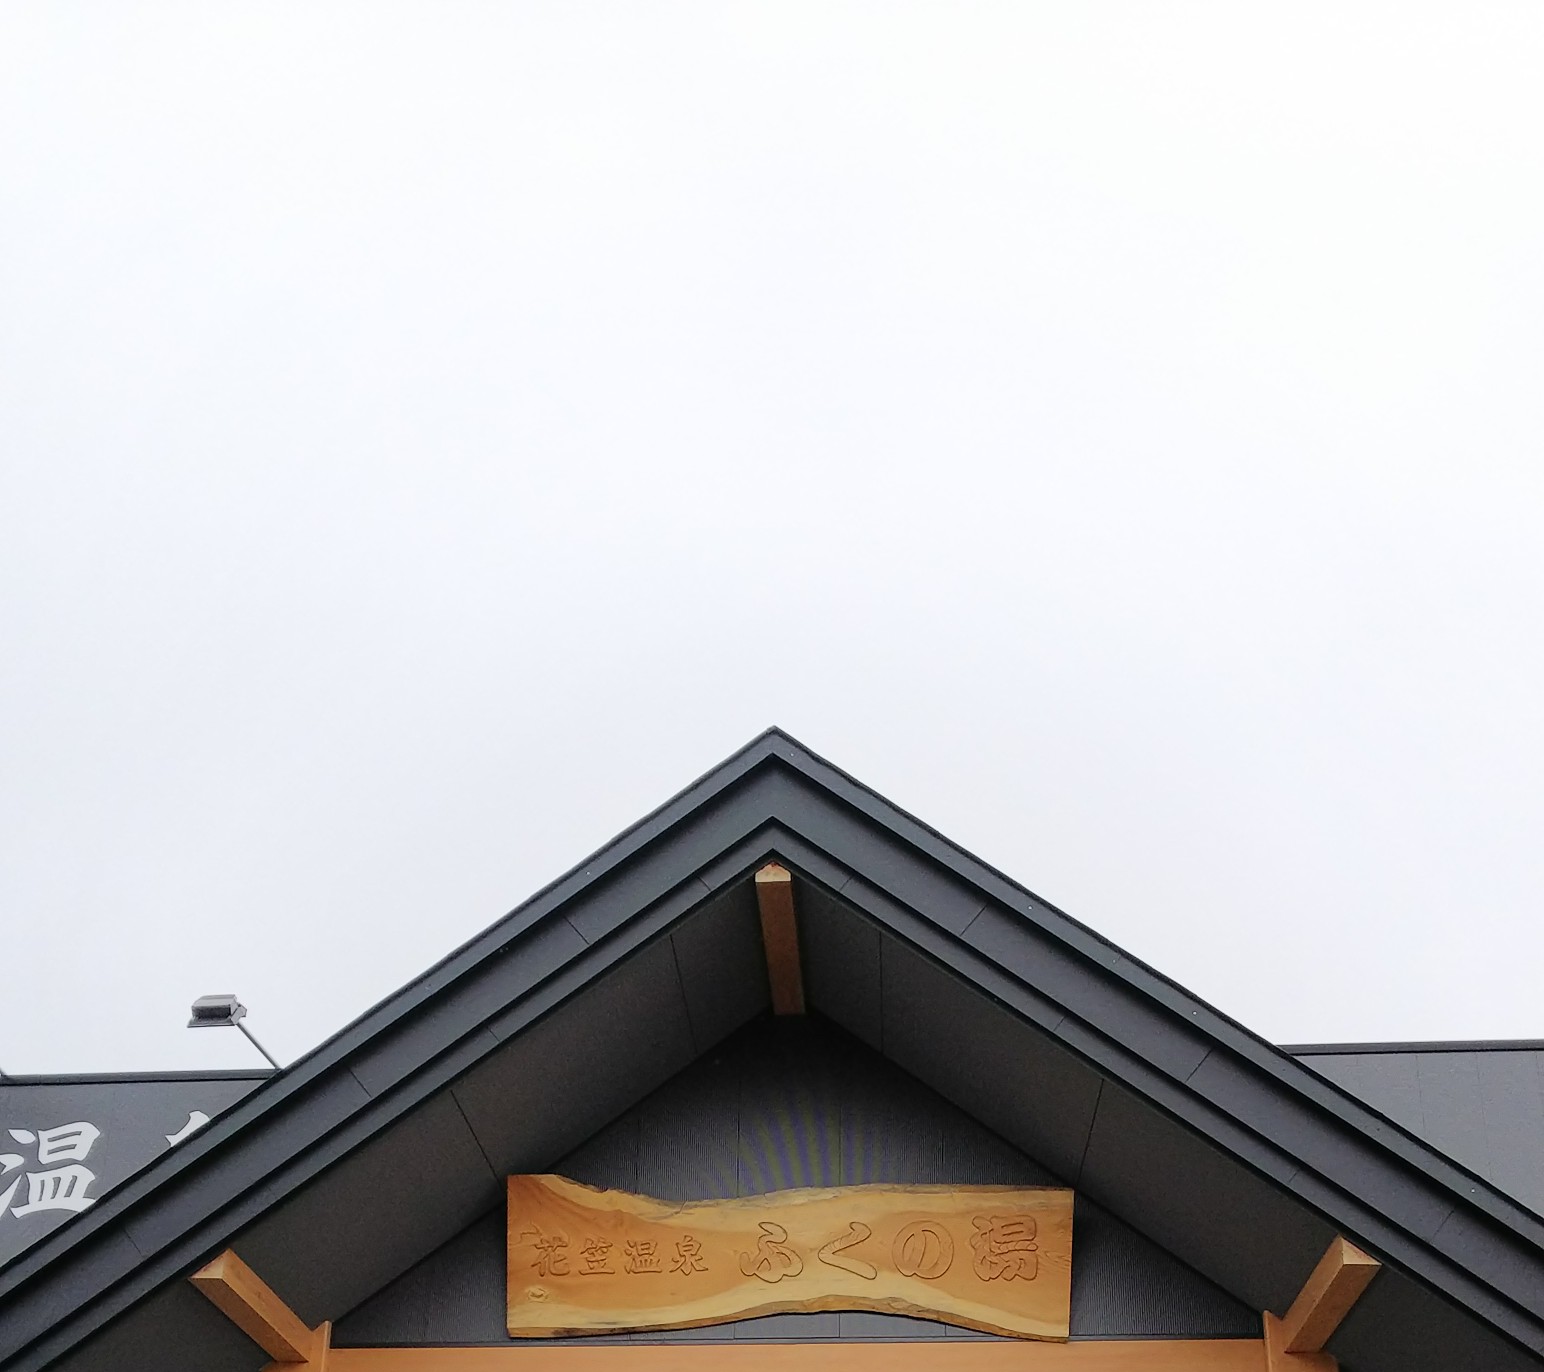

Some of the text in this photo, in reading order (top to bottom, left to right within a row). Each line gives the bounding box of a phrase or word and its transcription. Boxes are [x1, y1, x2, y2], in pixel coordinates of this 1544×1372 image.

[528, 1213, 1040, 1284] 花笠温泉 ふくの湯
